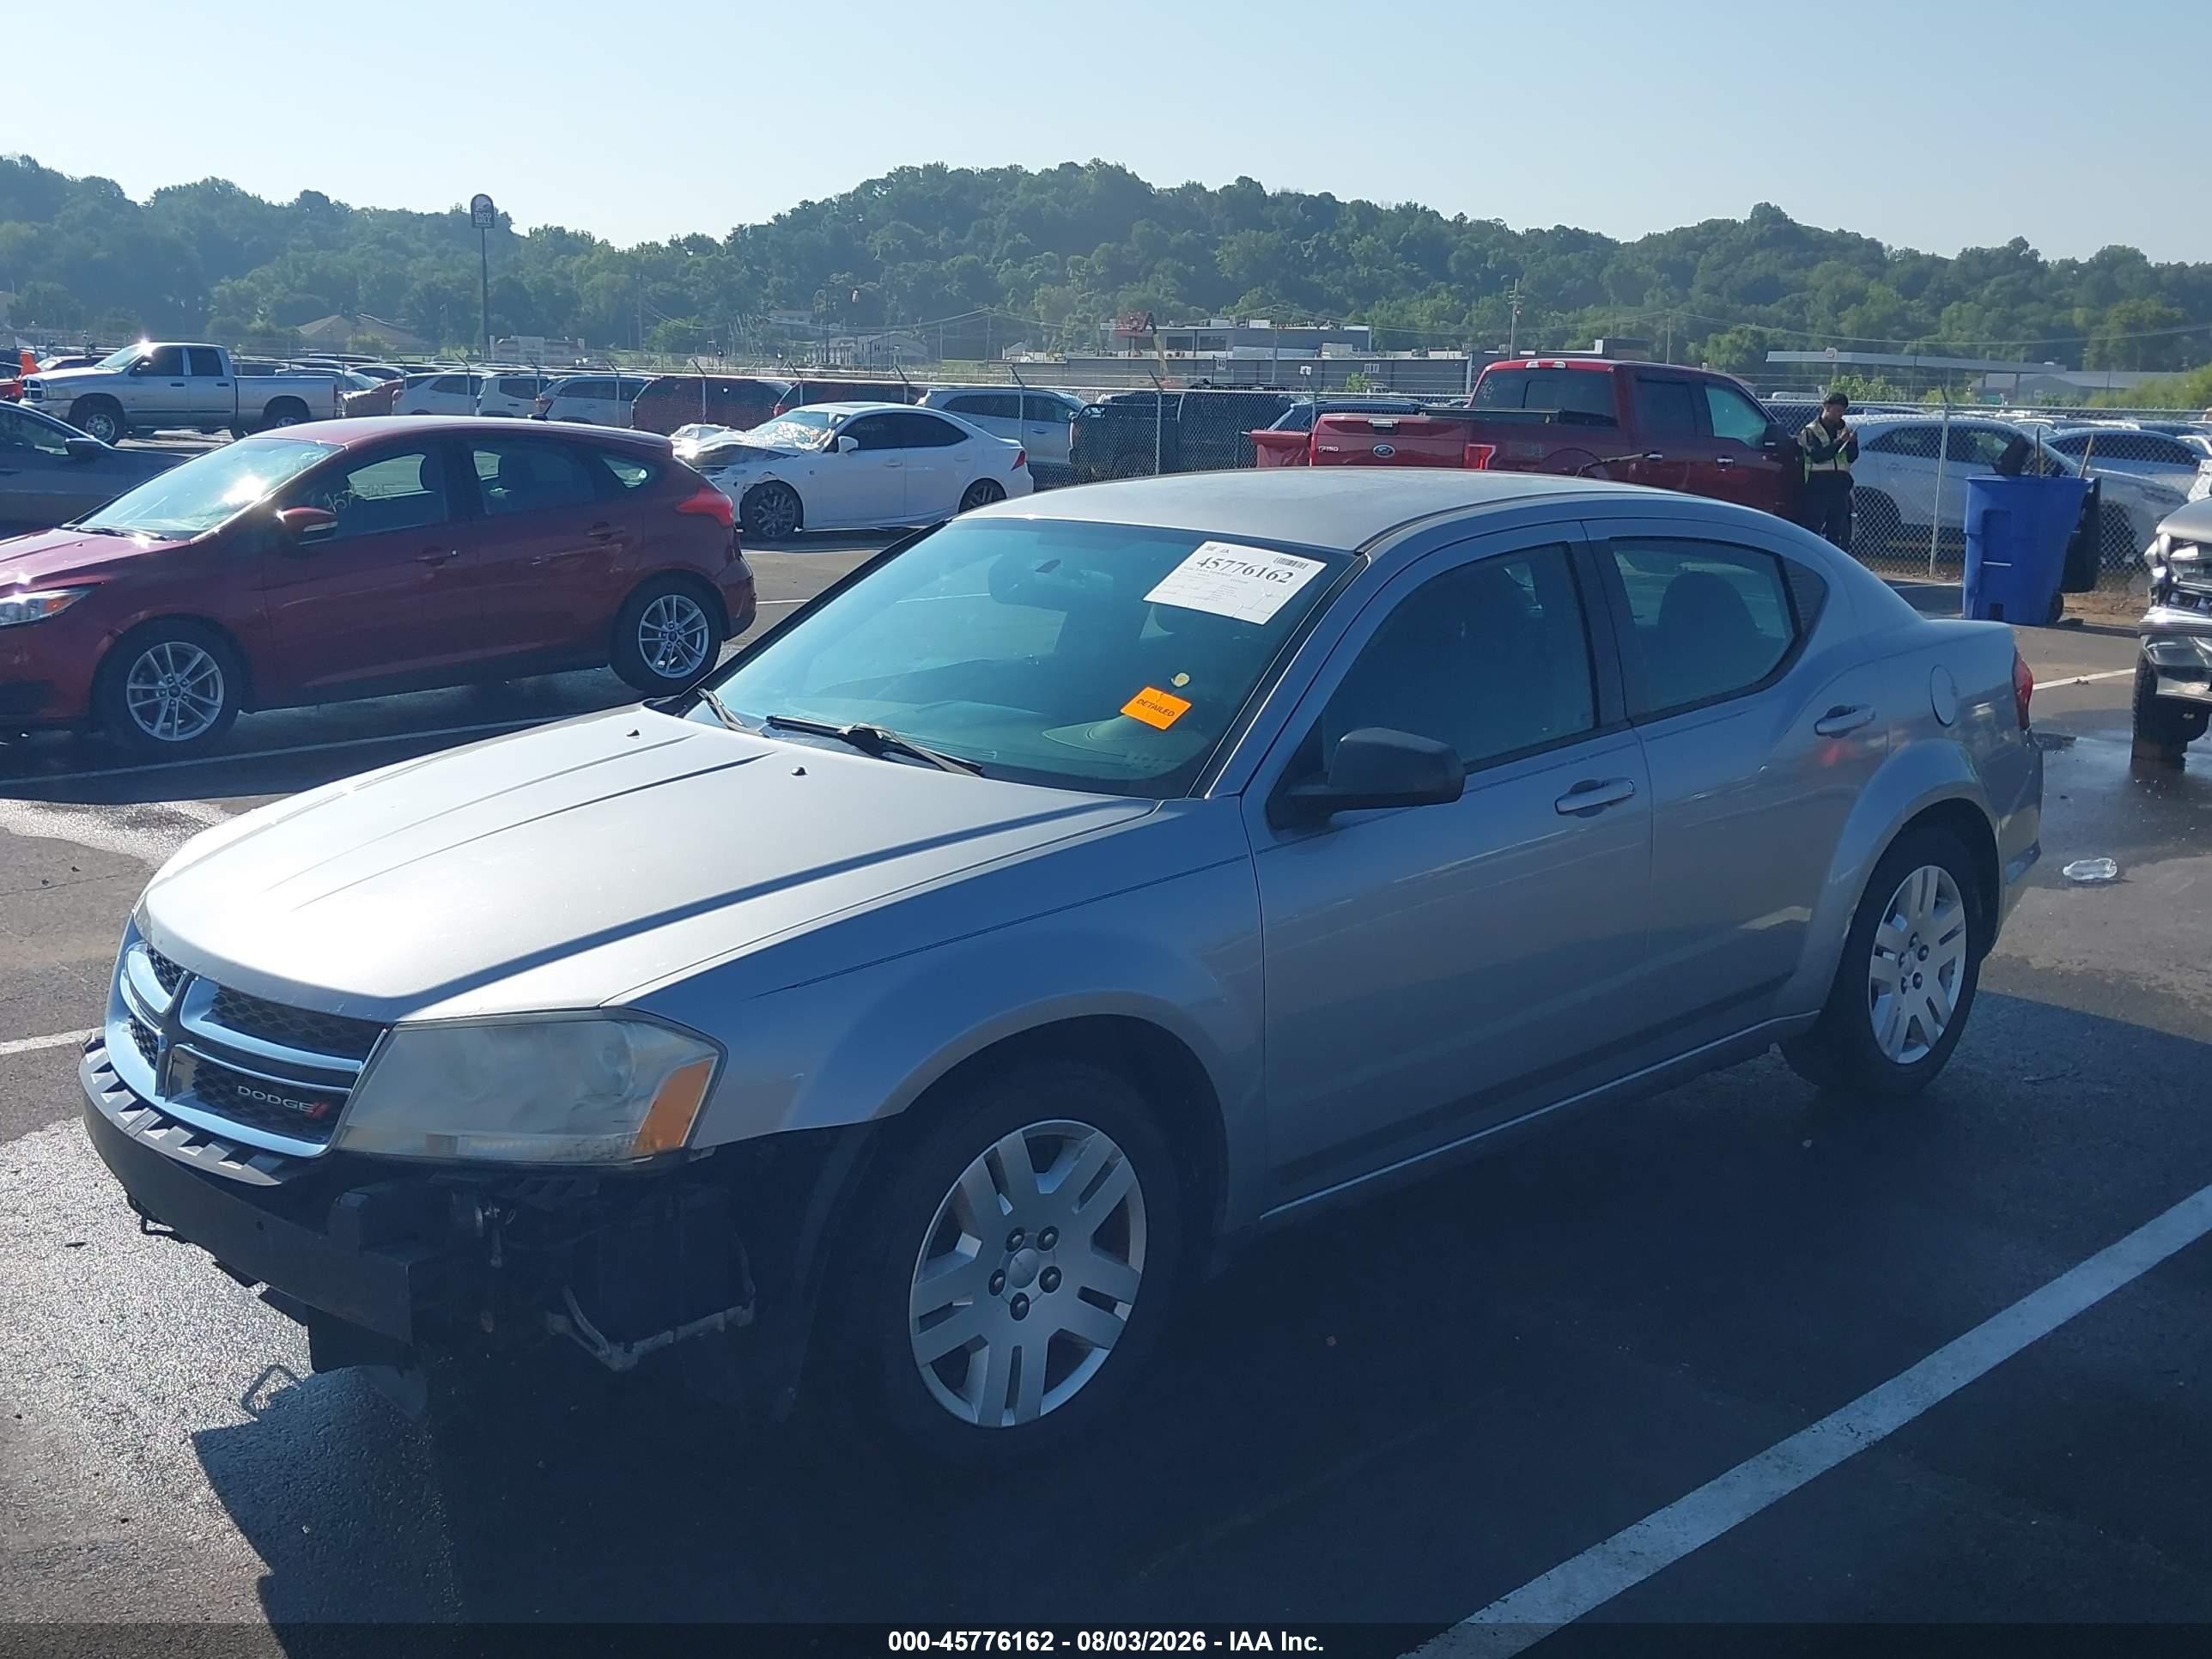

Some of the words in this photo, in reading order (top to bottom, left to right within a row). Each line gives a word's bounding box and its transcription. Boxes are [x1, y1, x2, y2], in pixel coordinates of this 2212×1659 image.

[1196, 556, 1294, 584] 45776162
[1135, 697, 1176, 716] DETAILED
[238, 1085, 315, 1113] DODGE
